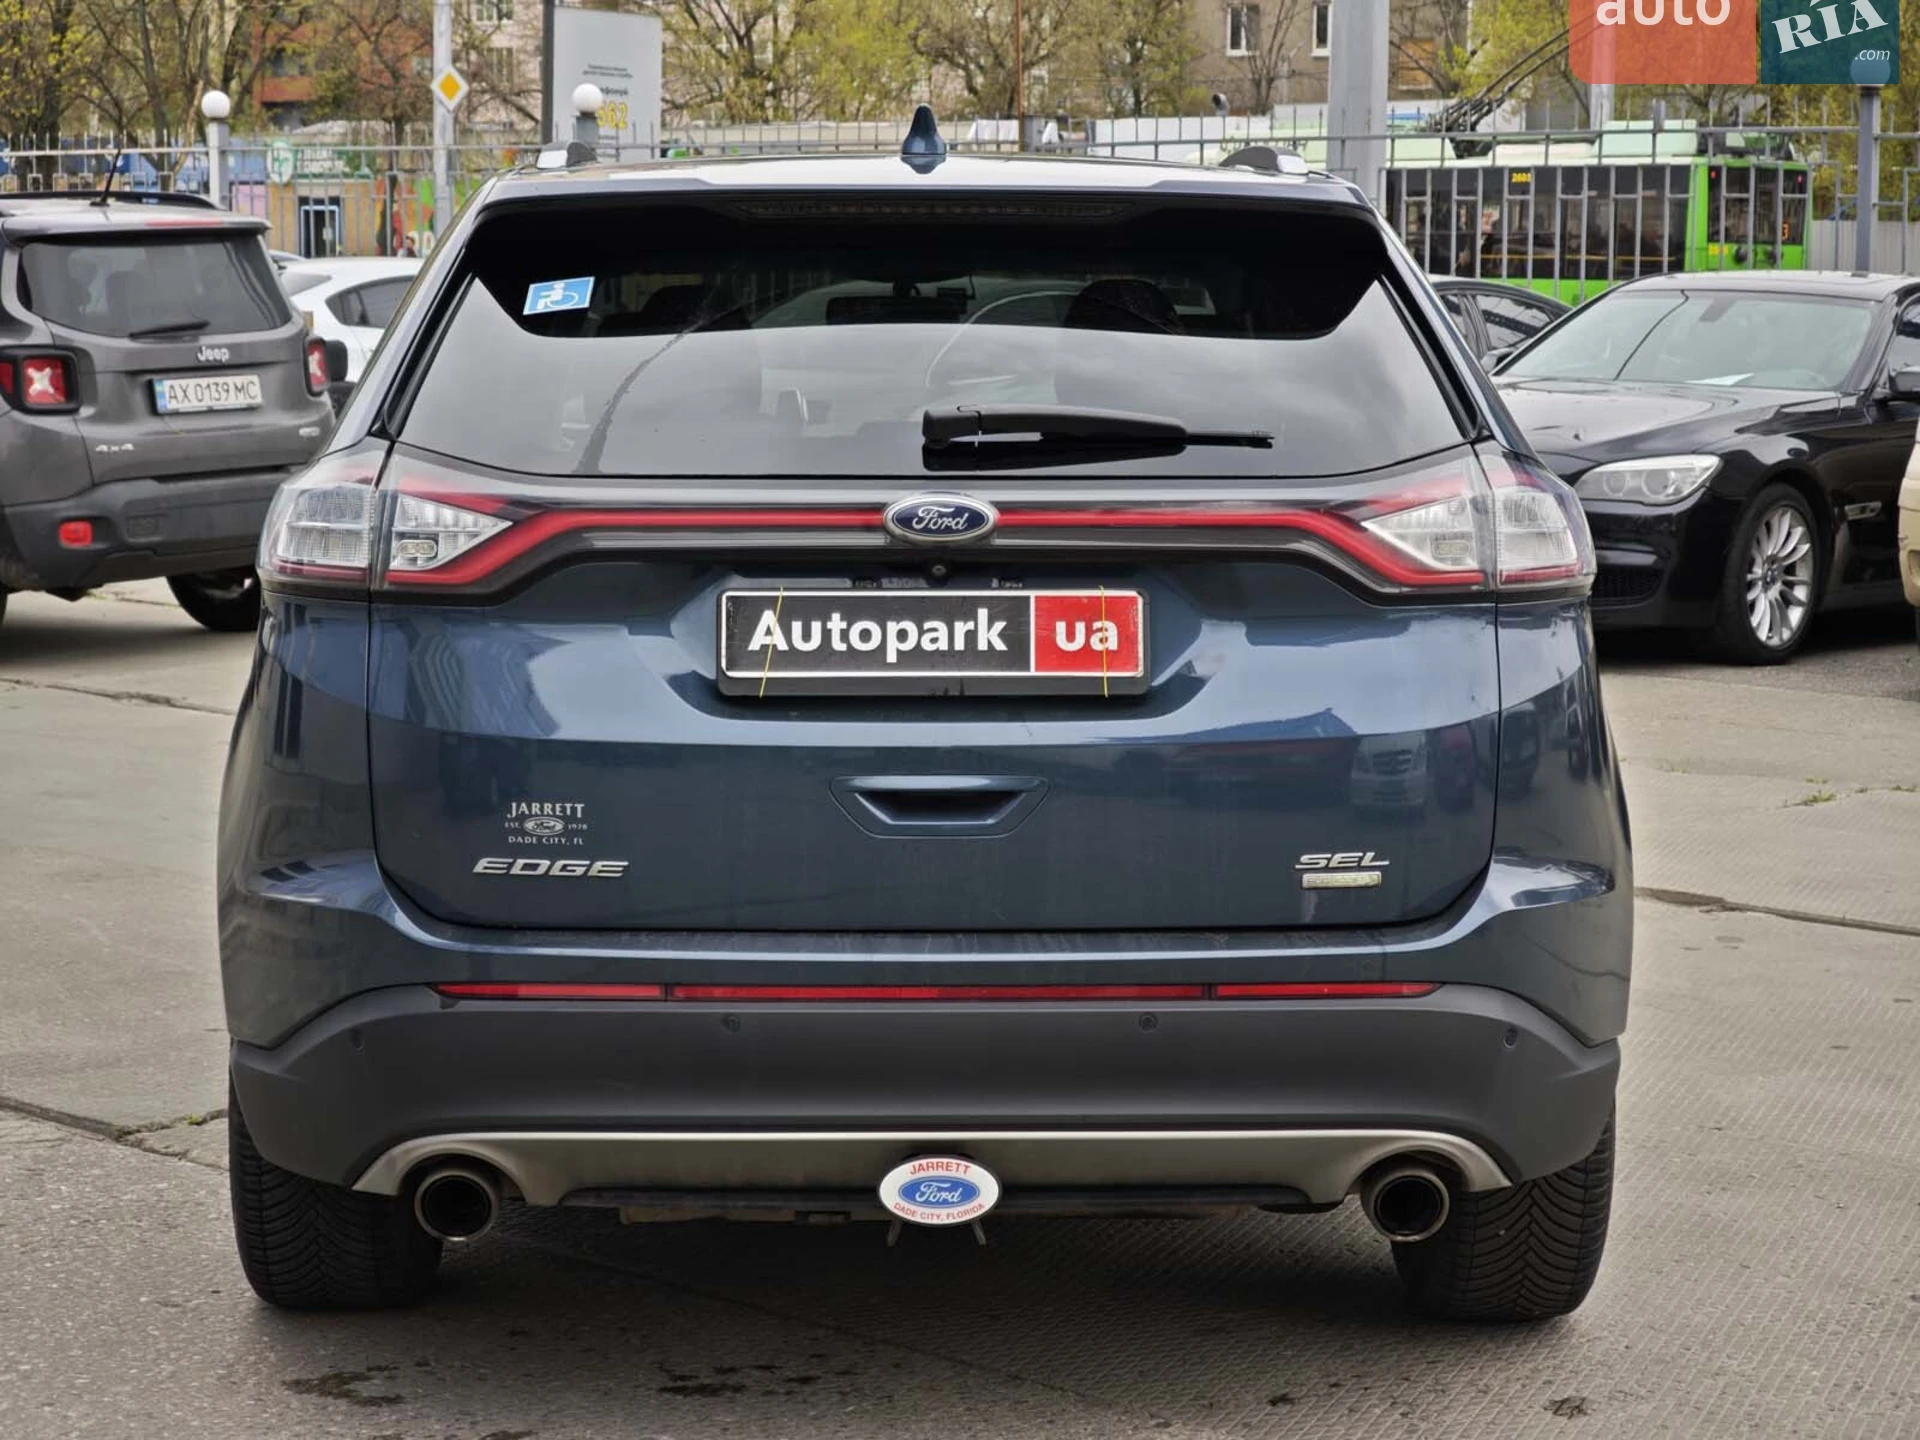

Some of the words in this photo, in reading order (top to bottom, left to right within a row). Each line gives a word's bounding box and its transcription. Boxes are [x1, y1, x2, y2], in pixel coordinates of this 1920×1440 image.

[197, 346, 230, 364] Jeep
[168, 384, 192, 404] AX
[194, 383, 230, 402] 0139
[234, 380, 258, 400] MC
[912, 506, 971, 532] Ford
[747, 608, 1008, 663] Autopark
[1055, 619, 1120, 652] ua
[506, 802, 585, 818] JARRETT
[508, 836, 538, 845] DADE
[542, 836, 570, 846] CITY,
[573, 837, 585, 846] FL
[472, 857, 630, 878] EDGE
[1294, 851, 1391, 869] SEL
[909, 1160, 971, 1176] JARRETT
[915, 1181, 964, 1203] Ford
[893, 1202, 919, 1218] DADE
[919, 1211, 943, 1222] CITY,
[945, 1202, 986, 1221] FLORIDA
